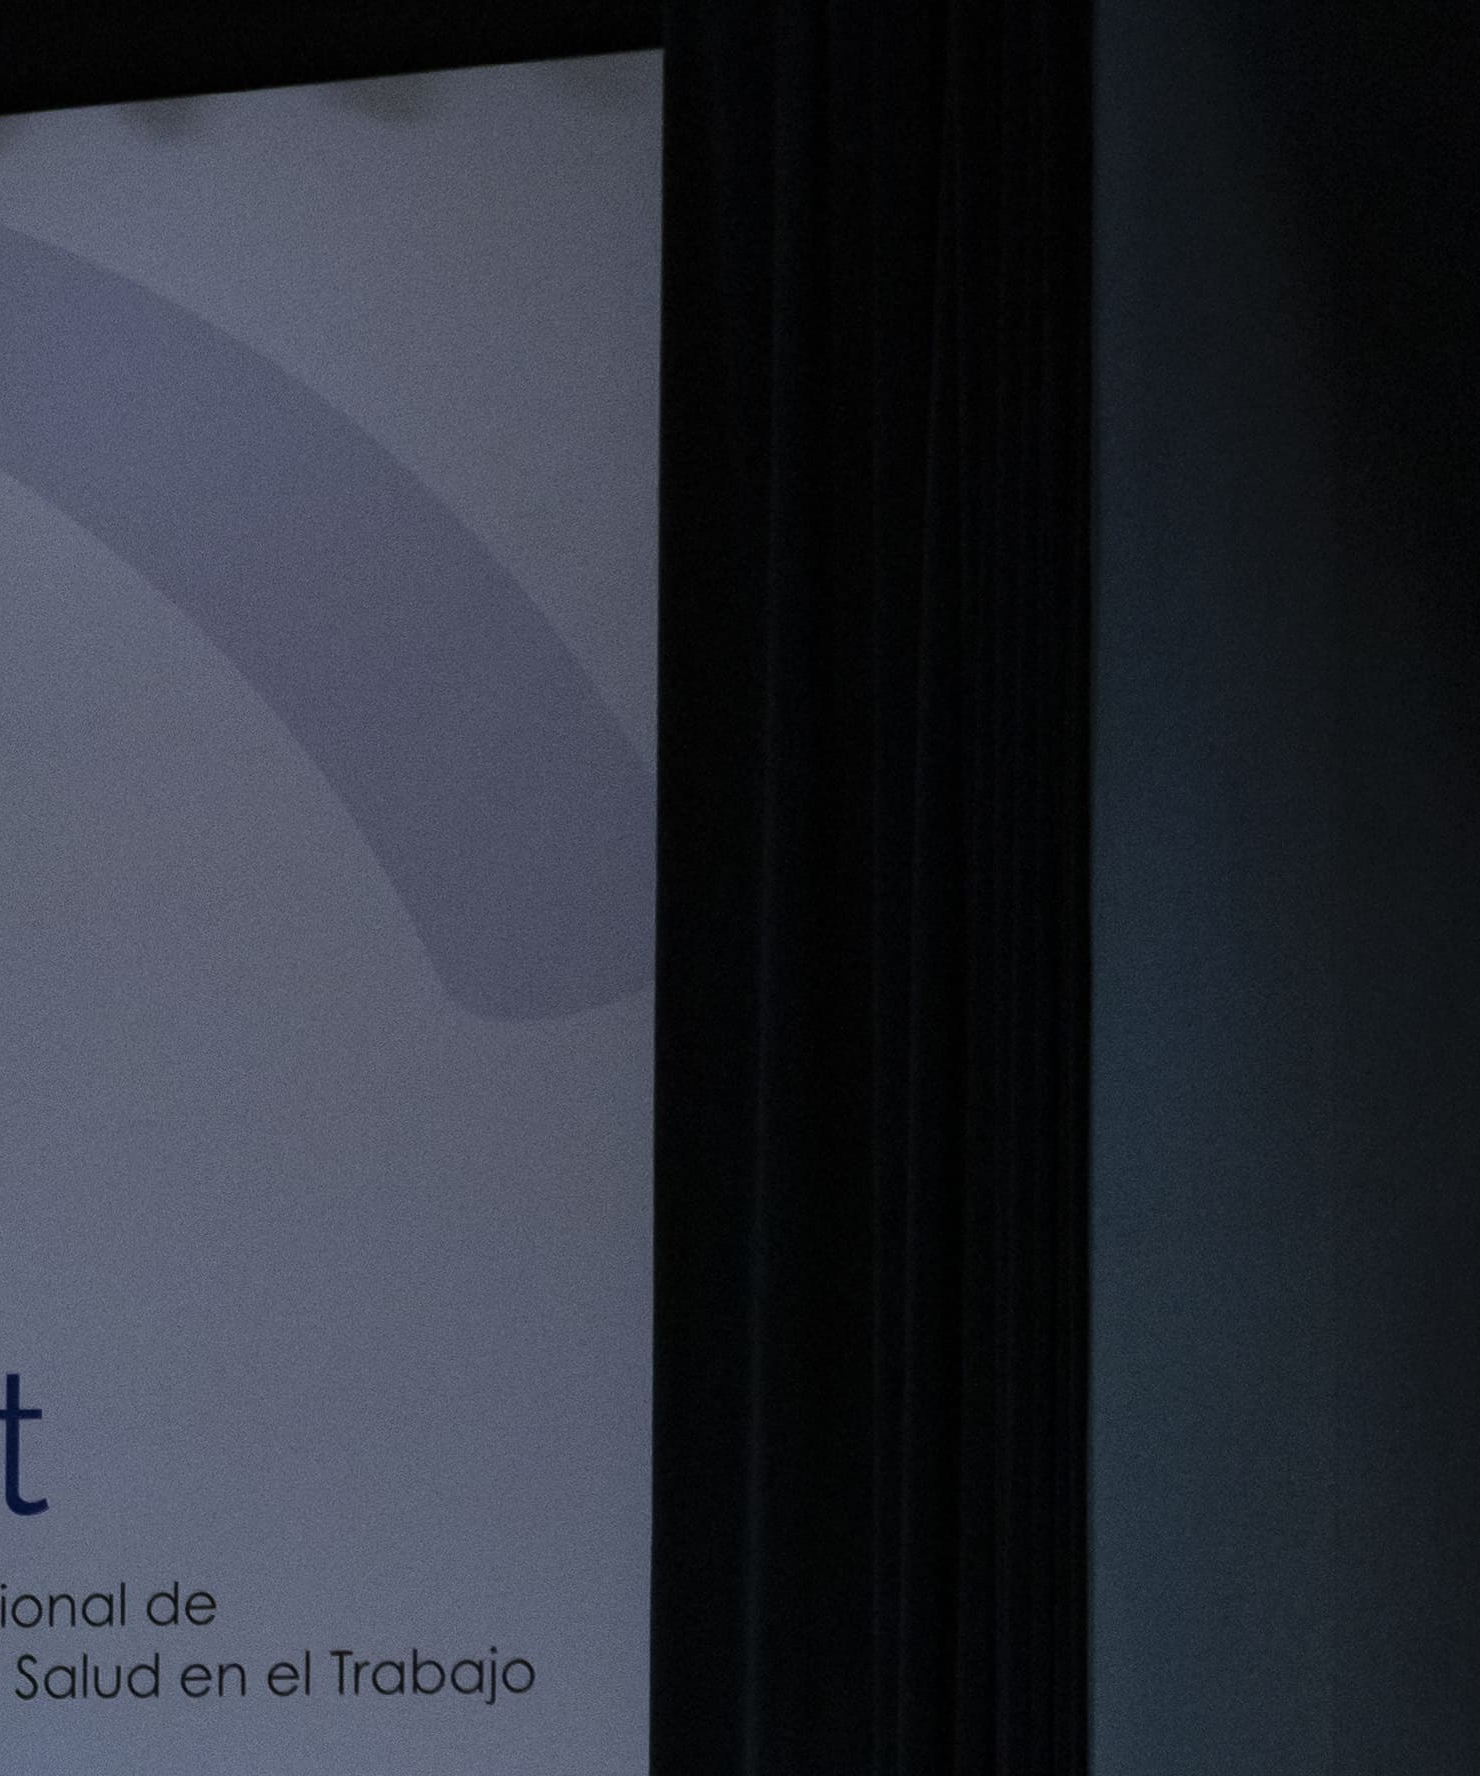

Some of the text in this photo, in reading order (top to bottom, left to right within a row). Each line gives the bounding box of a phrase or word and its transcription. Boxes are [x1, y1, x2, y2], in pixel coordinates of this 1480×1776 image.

[146, 1581, 217, 1627] de
[15, 1651, 159, 1701] Salud
[180, 1663, 246, 1698] en
[267, 1649, 311, 1697] el
[330, 1646, 536, 1706] Trabajo
